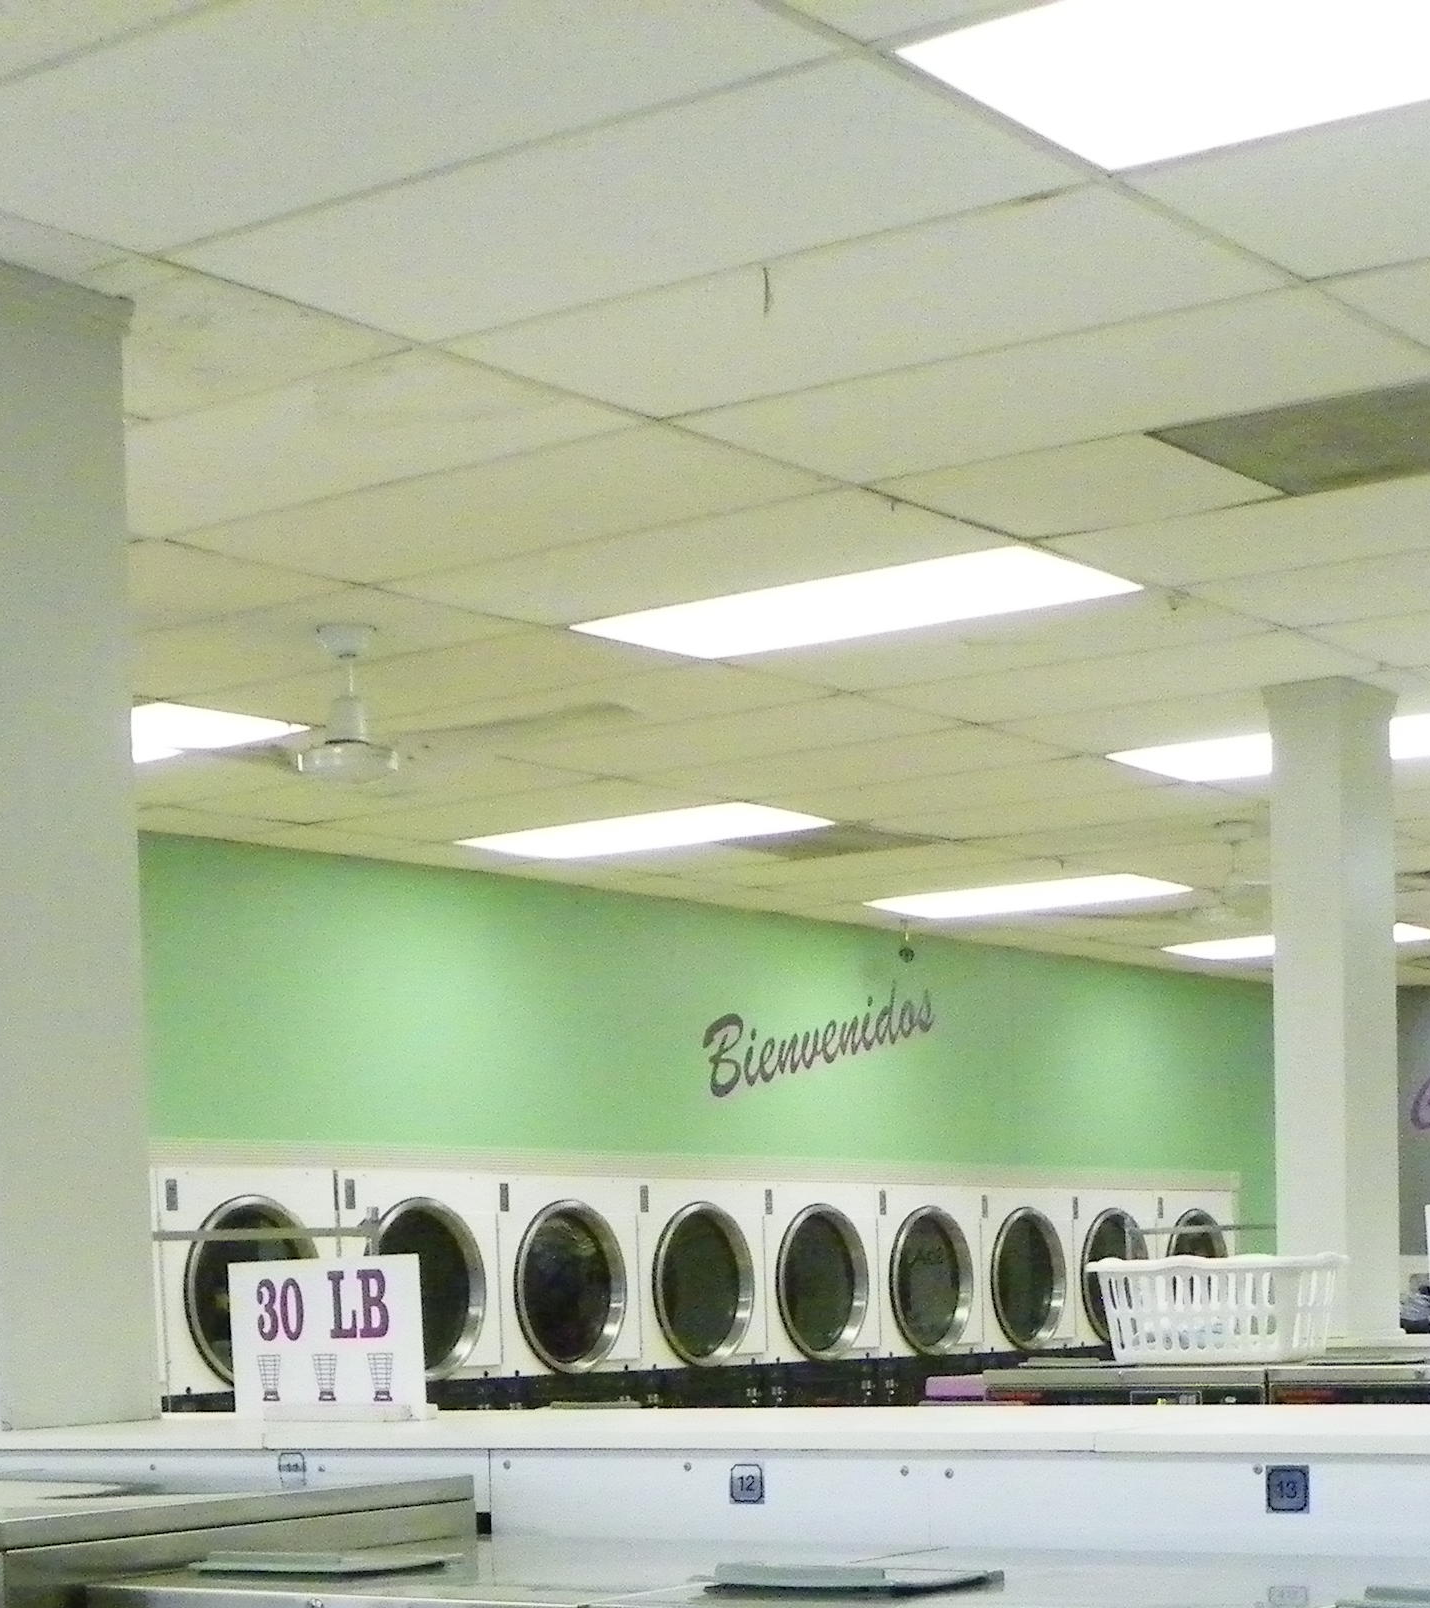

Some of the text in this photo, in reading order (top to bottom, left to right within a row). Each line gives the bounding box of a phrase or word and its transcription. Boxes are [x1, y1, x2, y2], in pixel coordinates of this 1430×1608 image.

[702, 978, 935, 1098] Bienvenidos
[257, 1268, 391, 1342] 30 LB
[737, 1475, 756, 1492] 12
[1275, 1479, 1298, 1499] 13
